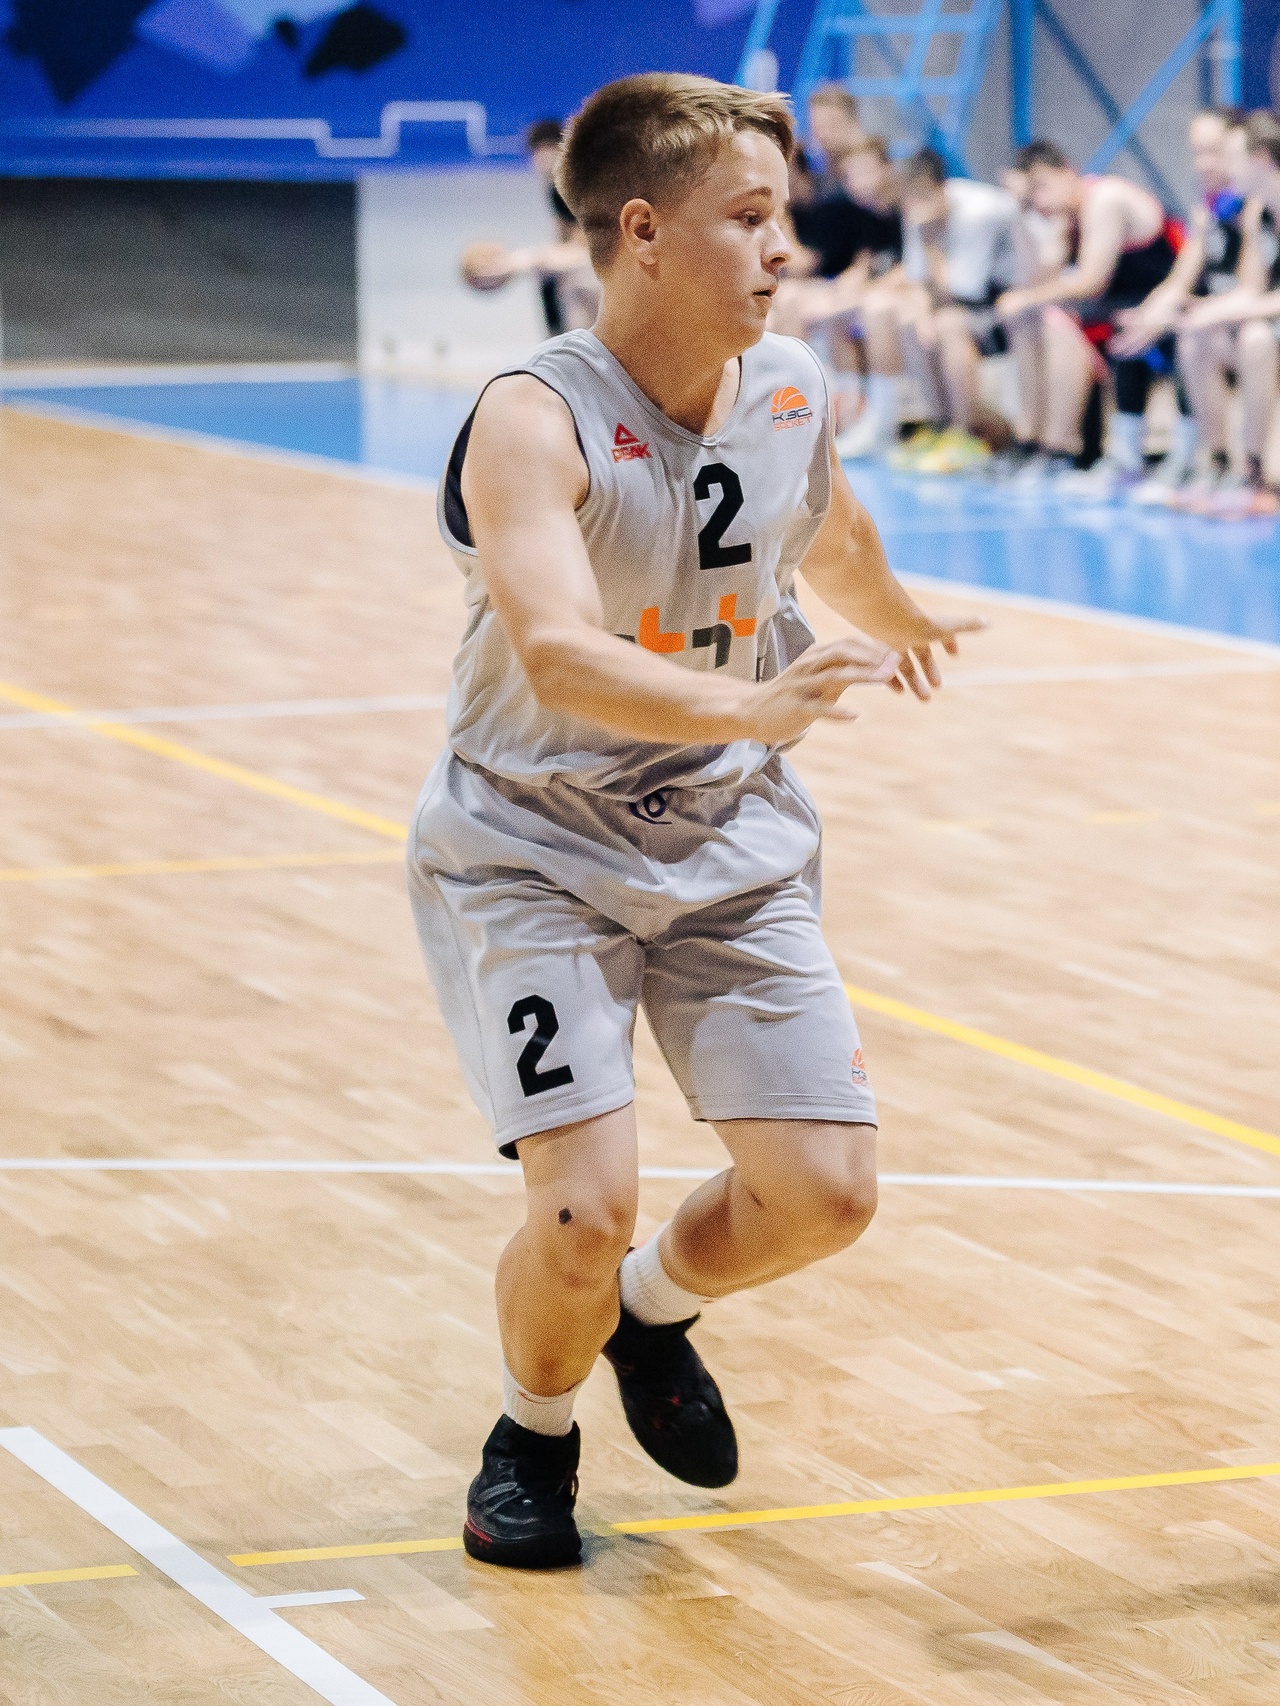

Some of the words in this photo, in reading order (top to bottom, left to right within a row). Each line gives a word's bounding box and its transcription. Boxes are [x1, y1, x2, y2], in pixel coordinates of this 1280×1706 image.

[611, 442, 653, 463] PEAK
[694, 463, 752, 570] 2
[507, 994, 574, 1098] 2
